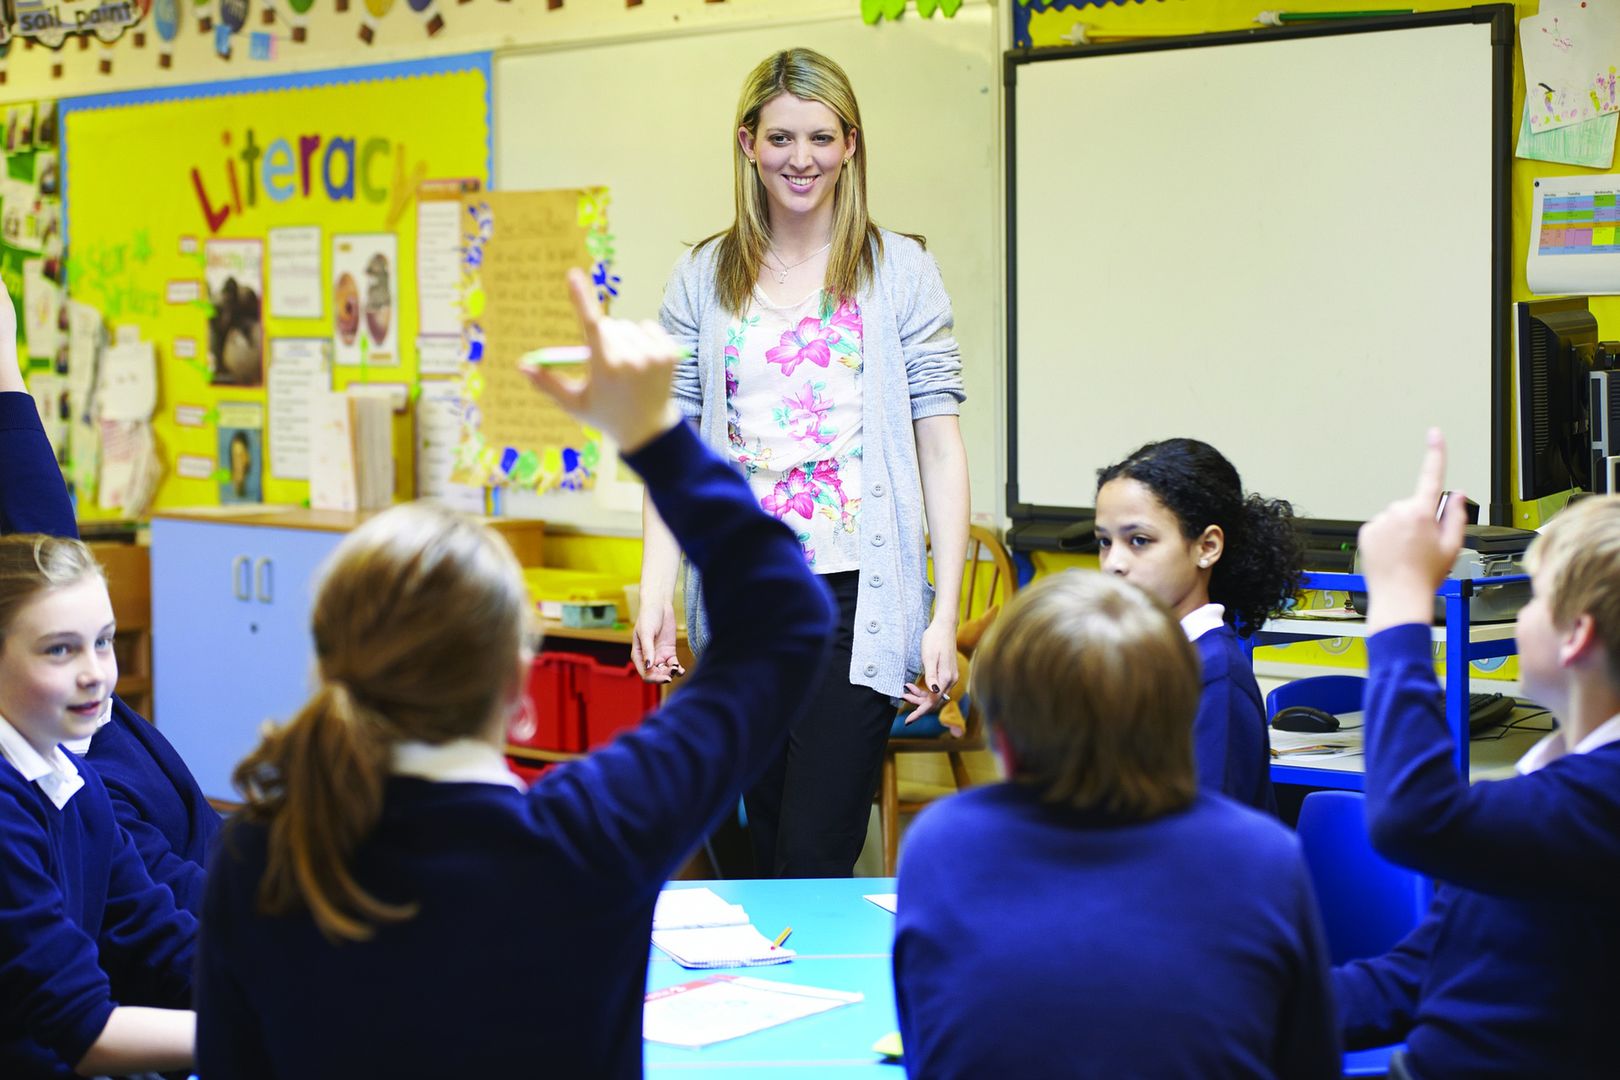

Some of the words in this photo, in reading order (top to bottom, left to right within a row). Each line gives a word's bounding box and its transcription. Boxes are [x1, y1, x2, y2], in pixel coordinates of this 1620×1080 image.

[20, 6, 61, 31] sail
[75, 1, 131, 33] paint
[190, 128, 429, 234] Literacy
